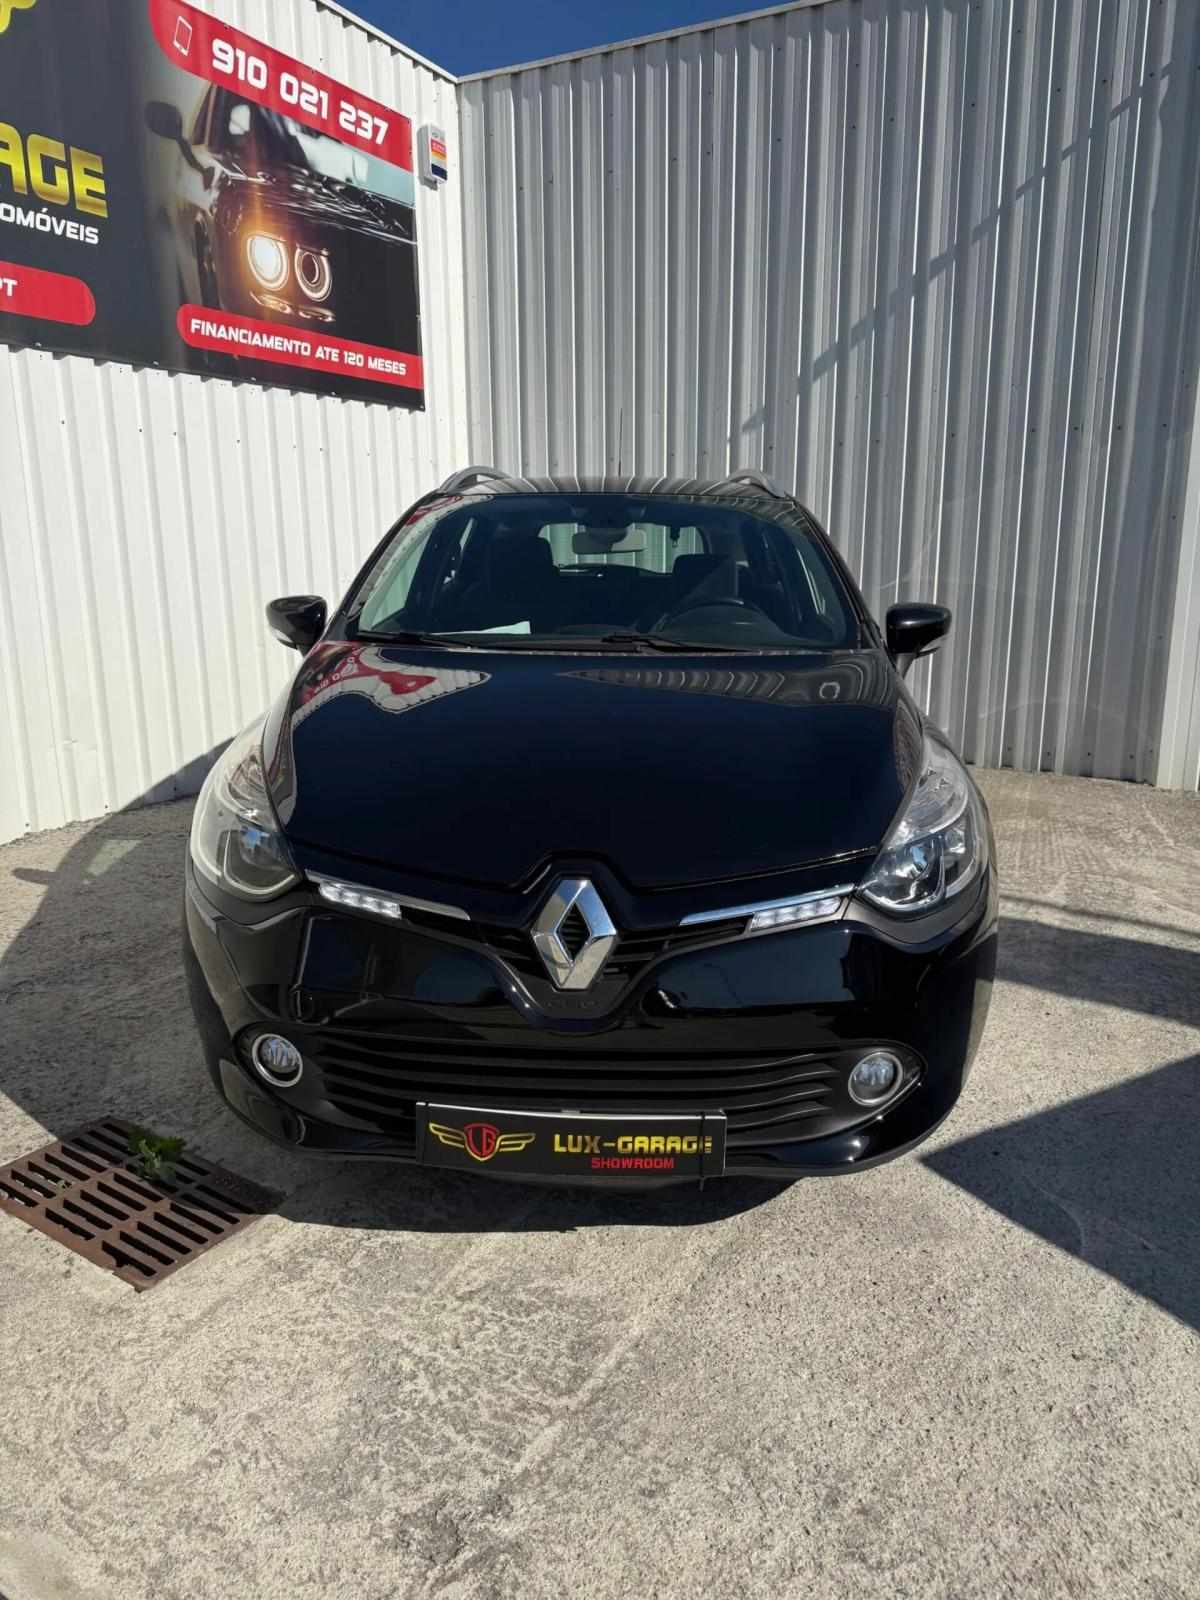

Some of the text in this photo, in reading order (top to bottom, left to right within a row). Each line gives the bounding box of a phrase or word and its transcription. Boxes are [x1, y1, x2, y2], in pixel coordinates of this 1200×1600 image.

[212, 38, 389, 145] 910 021 237
[190, 318, 407, 376] FINANCIAMENTO ATE 120 MESES
[553, 1133, 713, 1154] LUX-GARAGE
[591, 1157, 674, 1170] SHOWROOM
